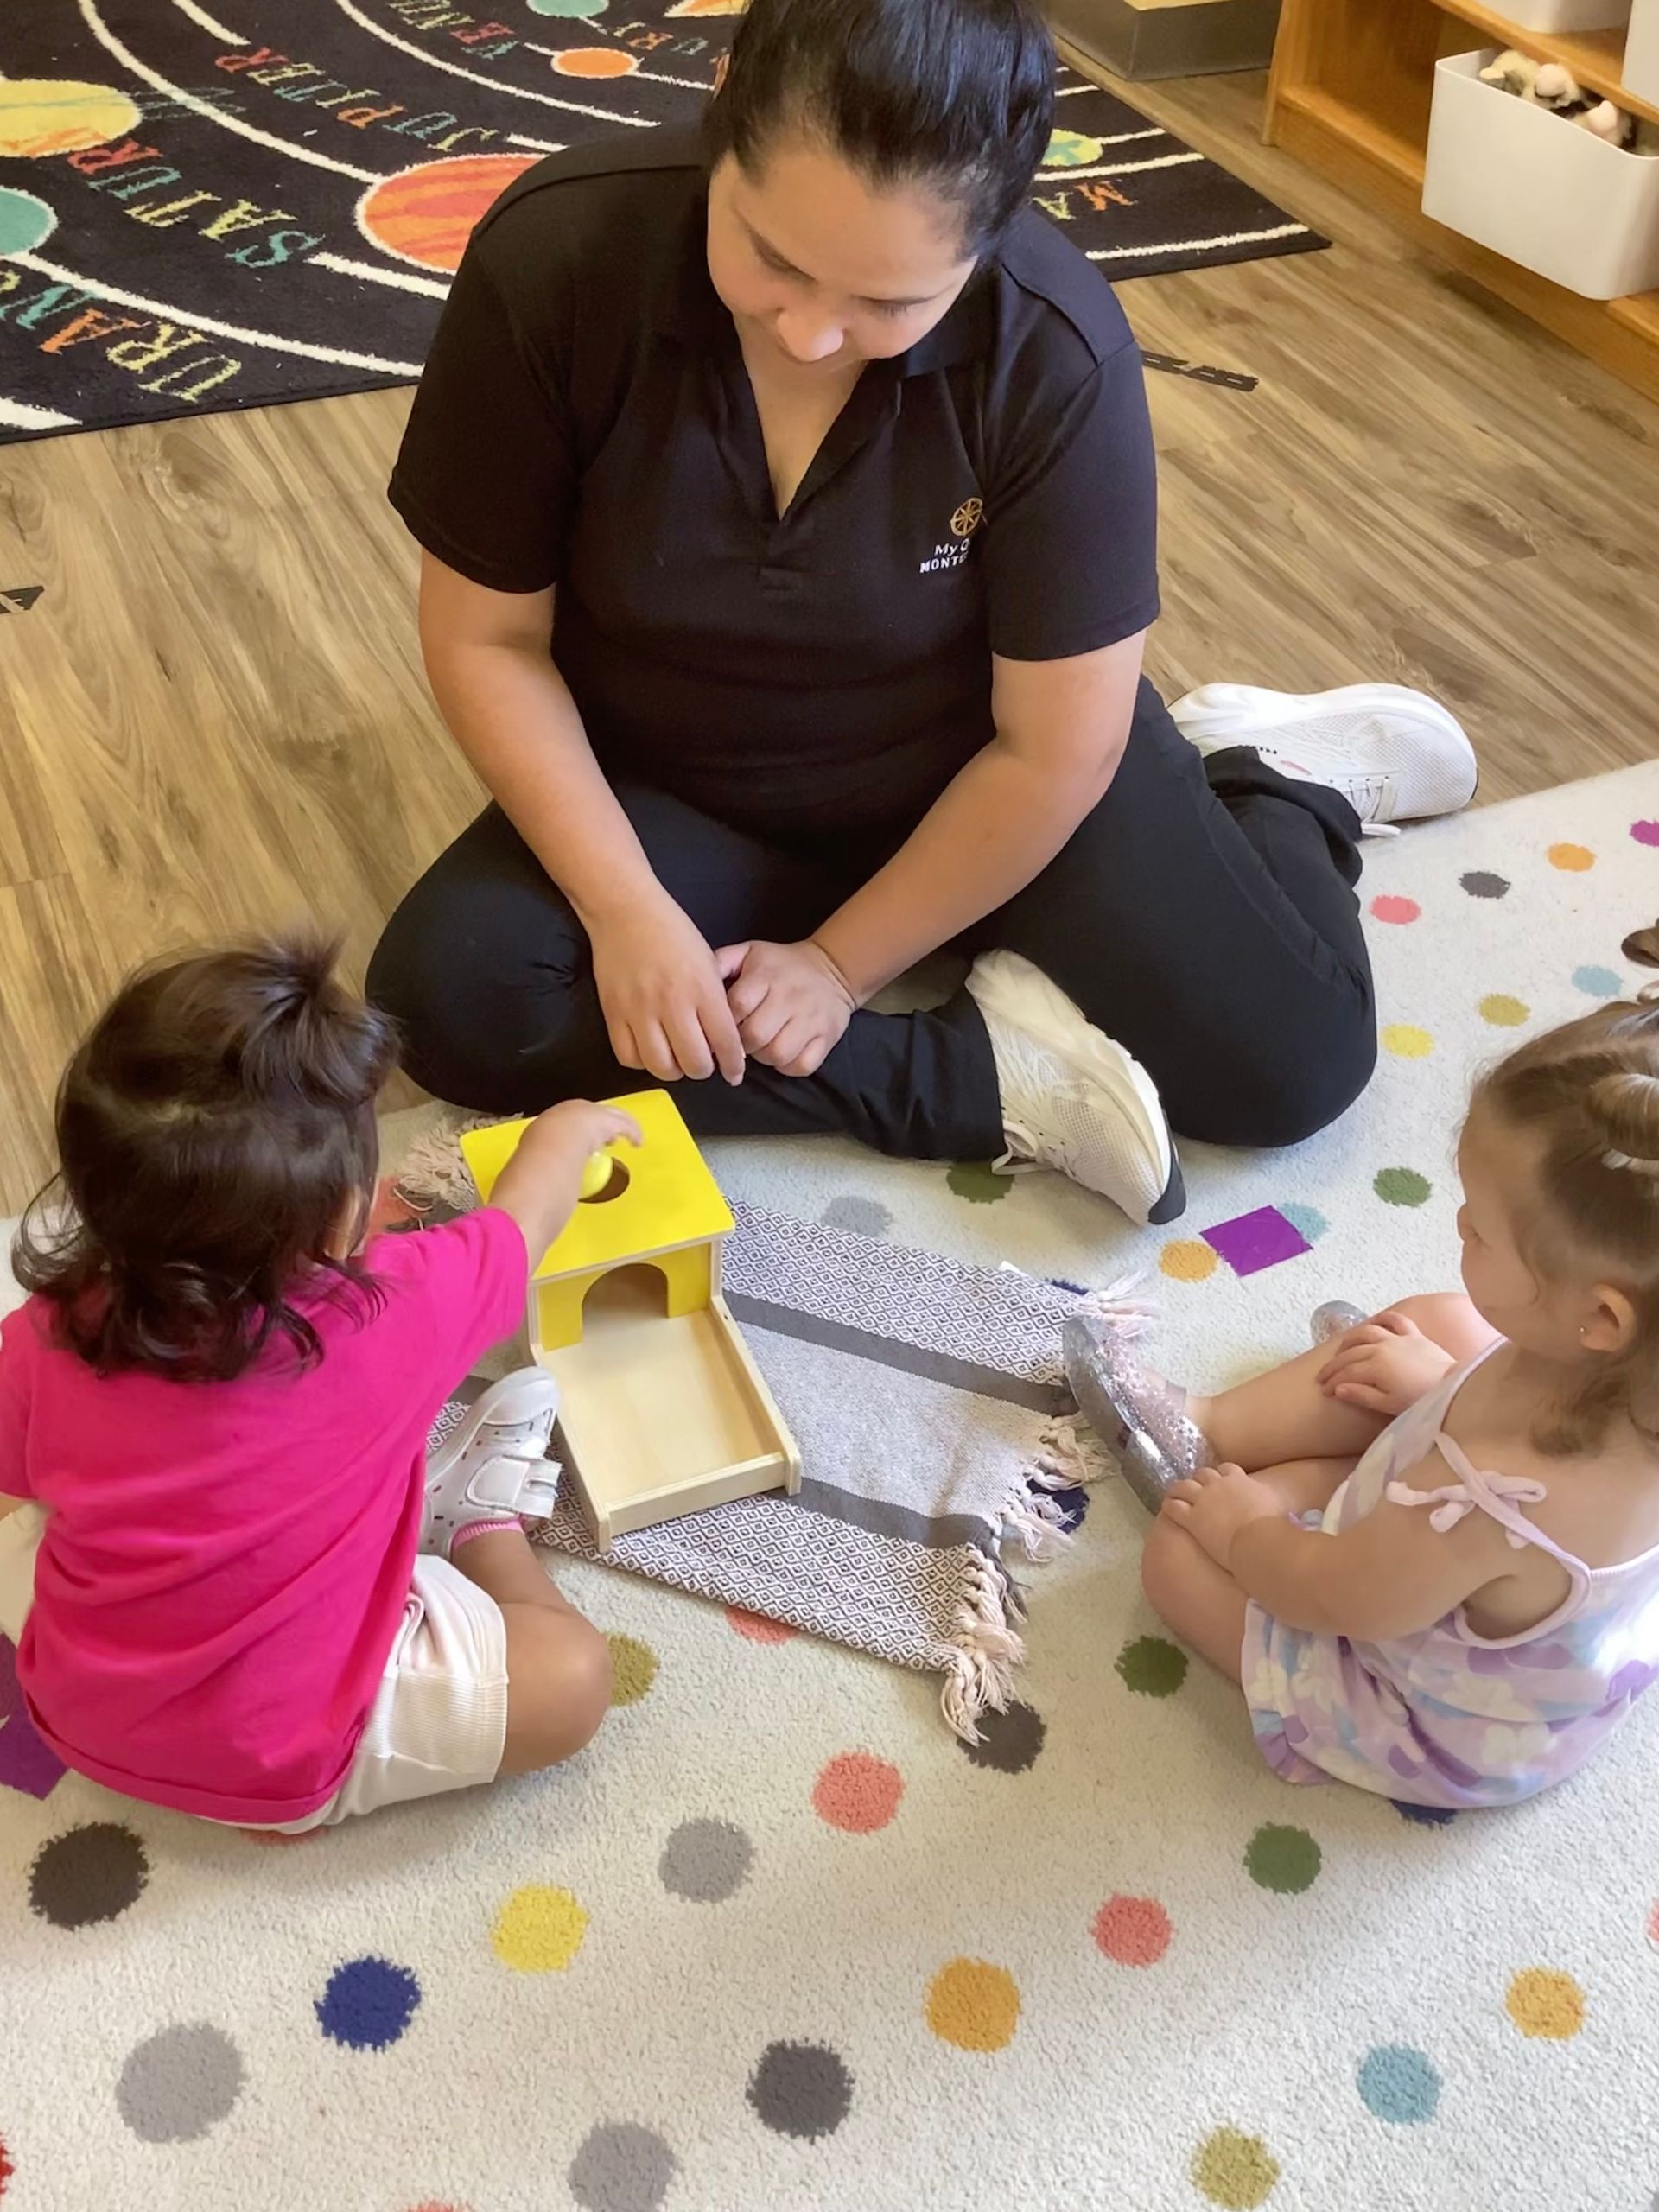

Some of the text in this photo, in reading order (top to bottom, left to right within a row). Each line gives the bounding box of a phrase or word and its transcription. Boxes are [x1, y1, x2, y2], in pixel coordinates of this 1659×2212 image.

[215, 47, 499, 152] JUPITER
[0, 269, 242, 404] URAN
[934, 543, 958, 556] My
